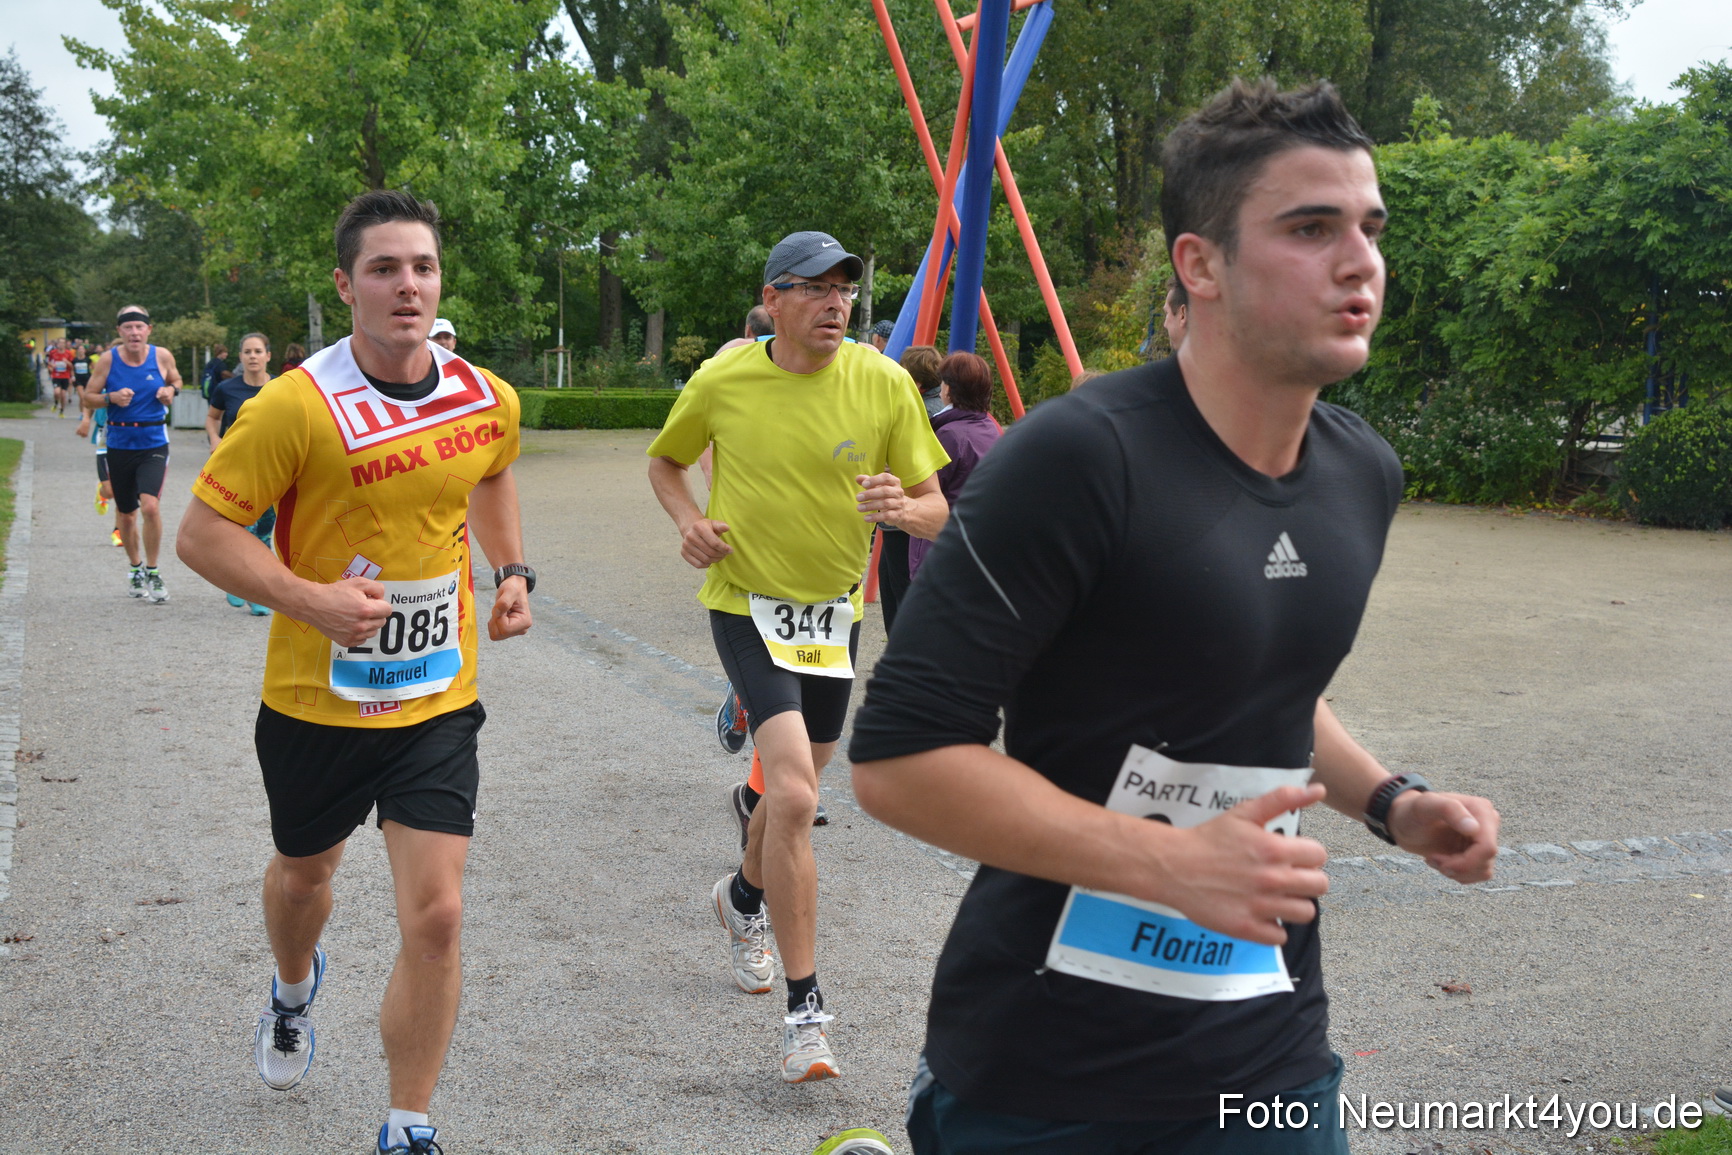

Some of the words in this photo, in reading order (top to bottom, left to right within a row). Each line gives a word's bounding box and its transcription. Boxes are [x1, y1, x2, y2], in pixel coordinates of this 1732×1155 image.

[350, 444, 430, 488] MAX
[433, 420, 505, 461] BÖGL
[847, 452, 867, 462] Ralf
[1263, 560, 1308, 580] adidas
[390, 588, 446, 605] Neumarkt
[347, 602, 450, 655] 085
[774, 603, 835, 641] 344
[368, 660, 428, 685] Manuel
[1122, 770, 1203, 808] PARTL
[1129, 920, 1235, 967] Florian
